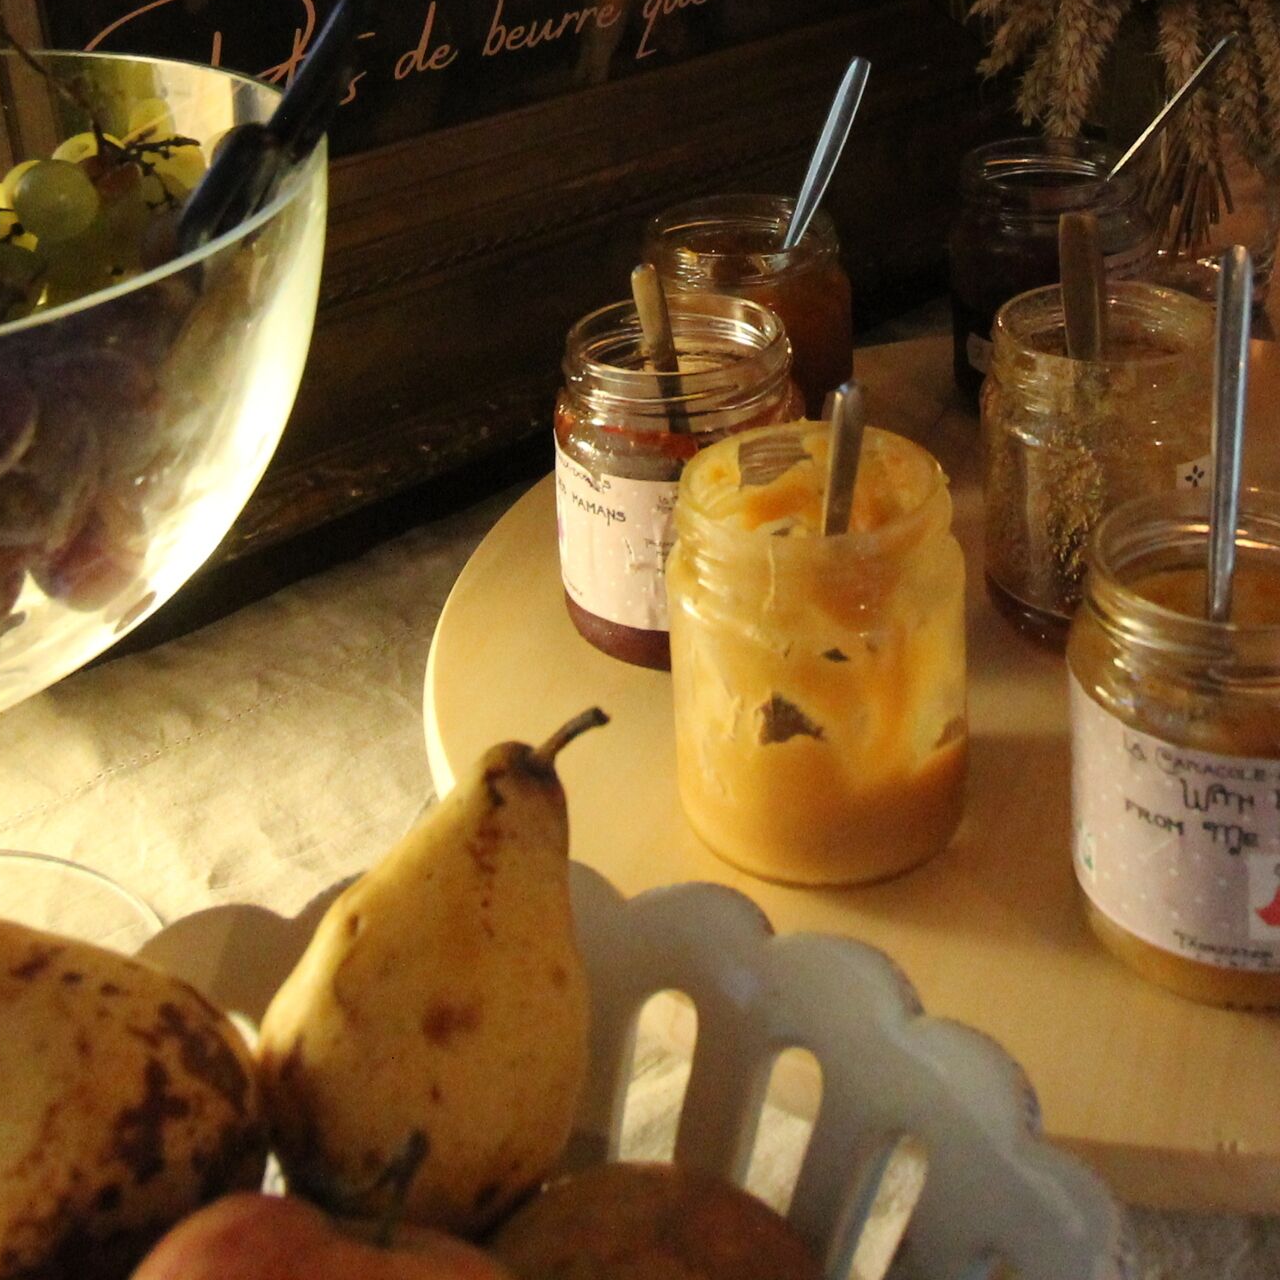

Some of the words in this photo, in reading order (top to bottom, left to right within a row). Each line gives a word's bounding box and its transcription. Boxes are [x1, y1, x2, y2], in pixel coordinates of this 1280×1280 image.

[393, 0, 460, 81] de
[1180, 778, 1256, 814] WITH
[1124, 798, 1185, 837] FROM
